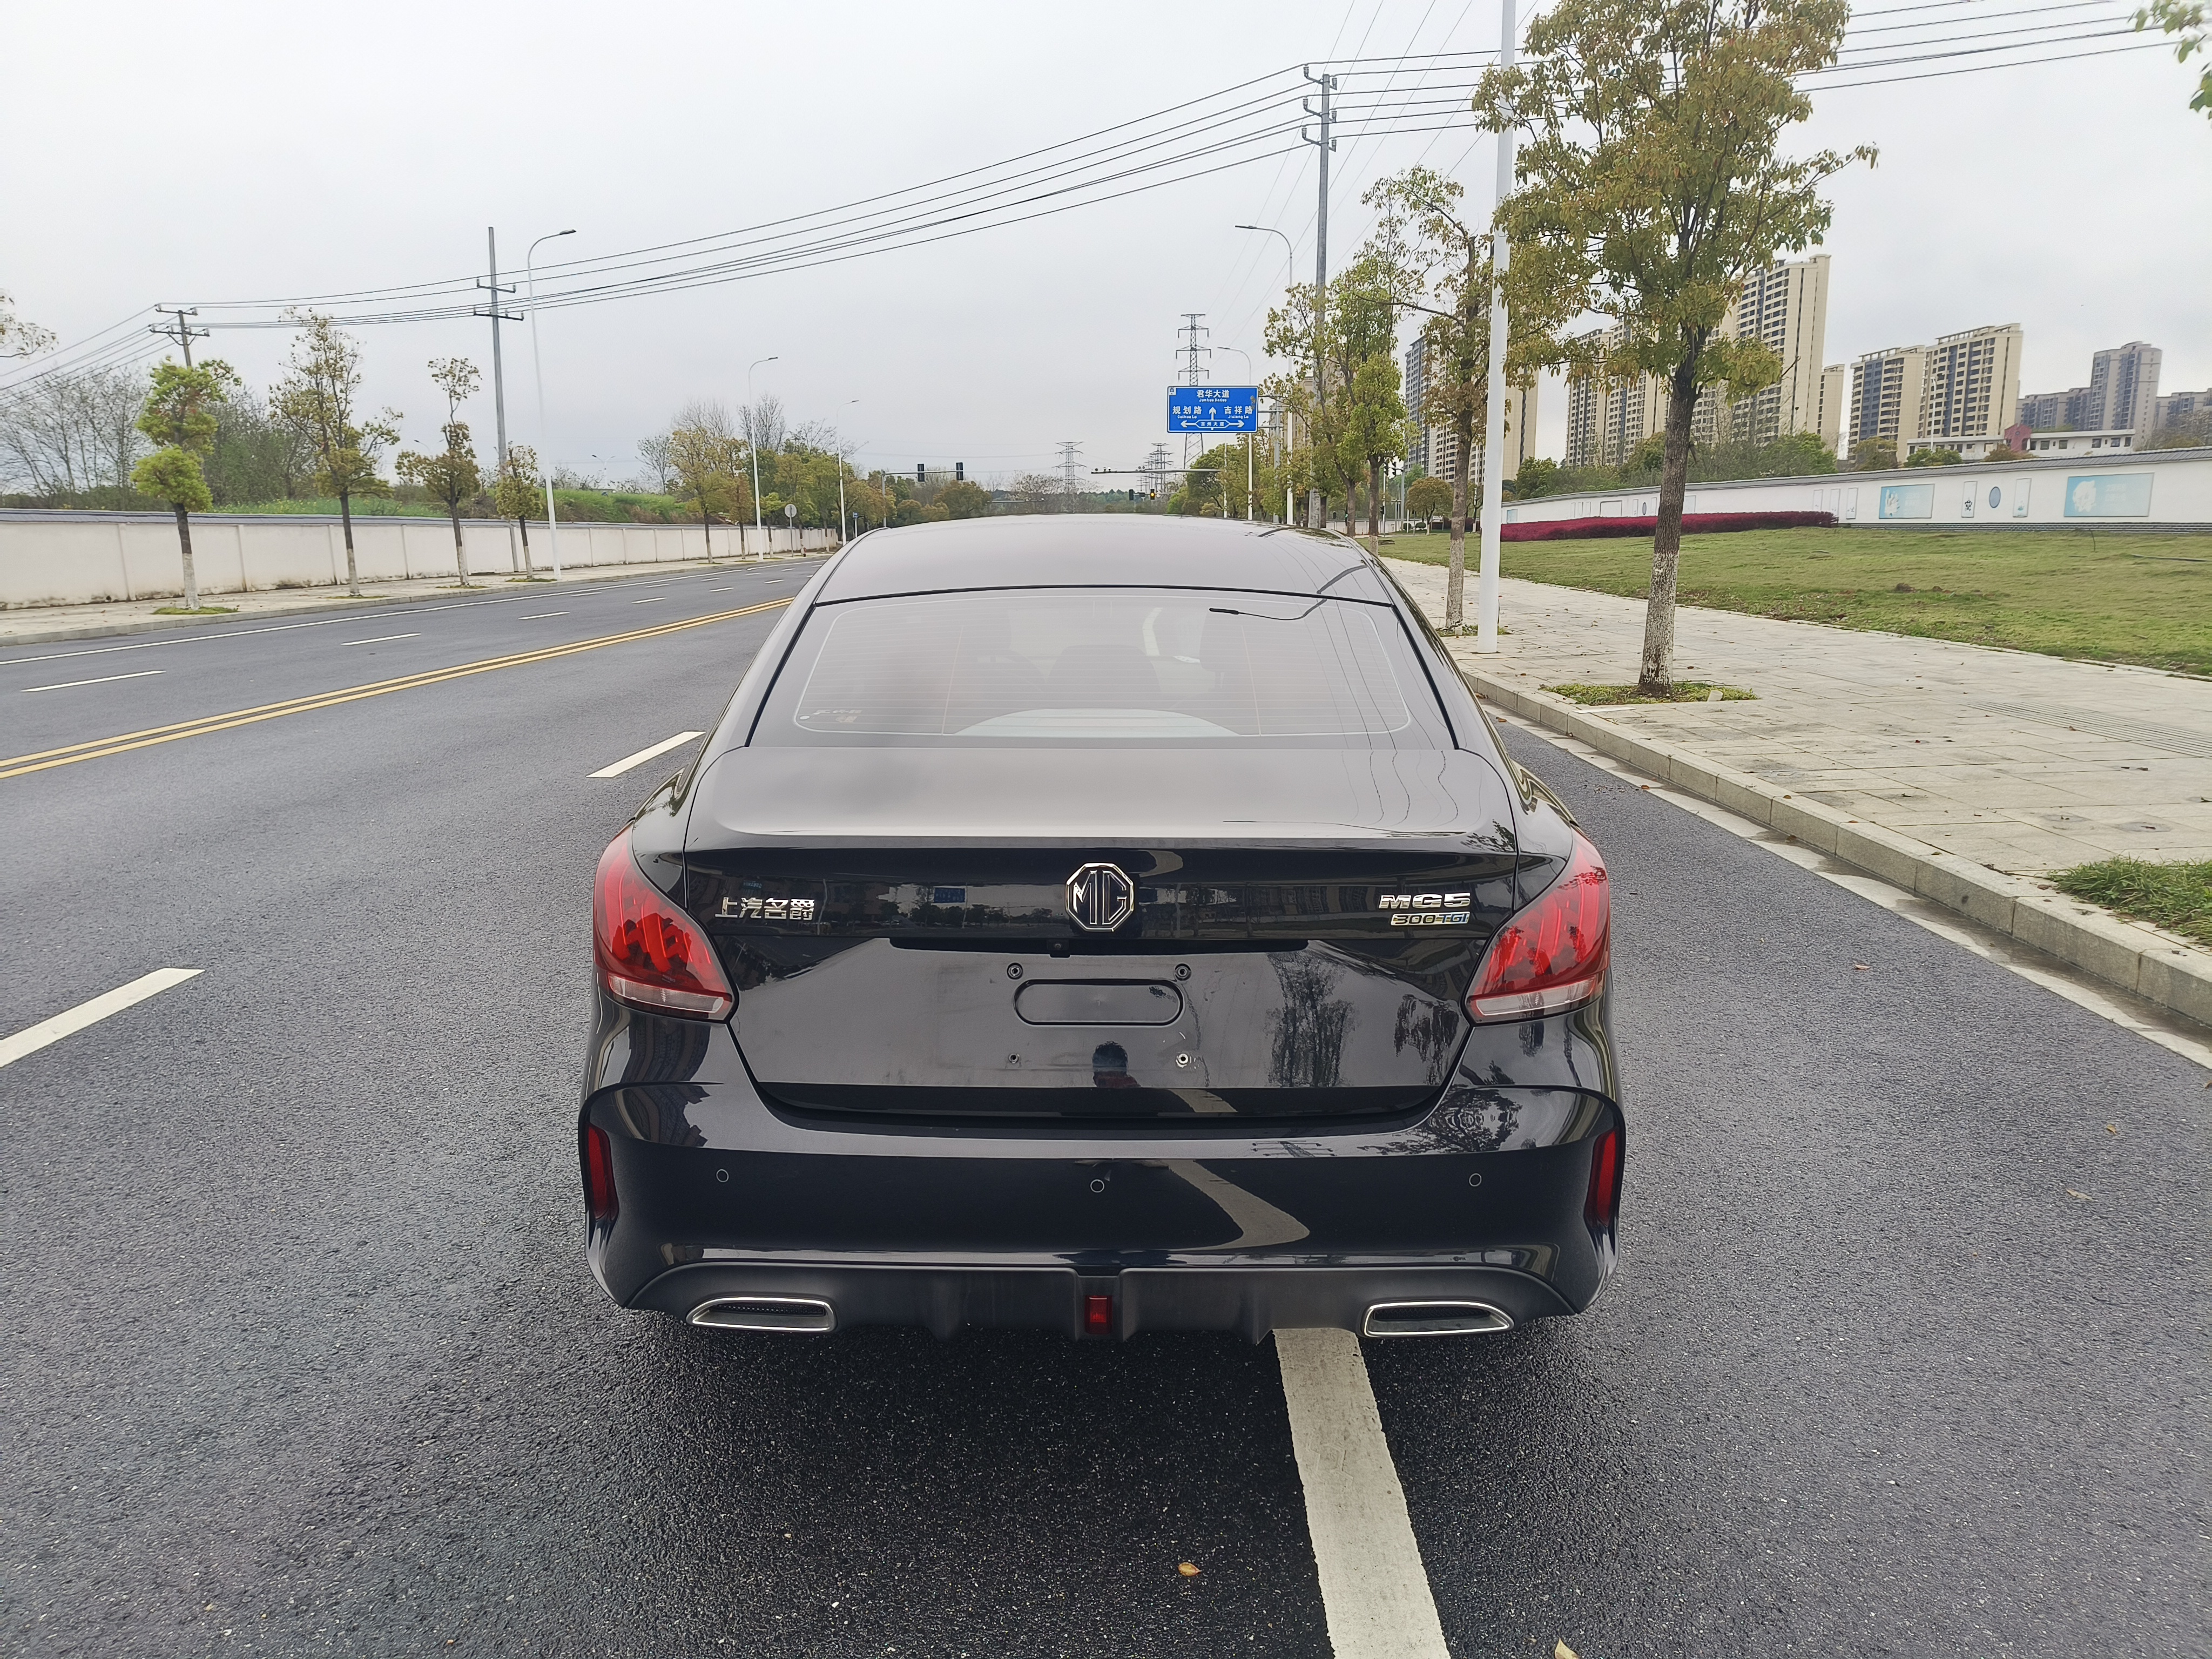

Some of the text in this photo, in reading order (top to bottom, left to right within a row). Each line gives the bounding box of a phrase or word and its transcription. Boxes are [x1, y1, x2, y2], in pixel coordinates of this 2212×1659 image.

[1196, 389, 1230, 398] 君华大道
[1172, 406, 1202, 414] 规划路
[1224, 406, 1253, 414] 吉祥路
[1073, 870, 1127, 925] MG
[1379, 893, 1471, 909] MG5
[715, 897, 814, 920] 上汽名爵
